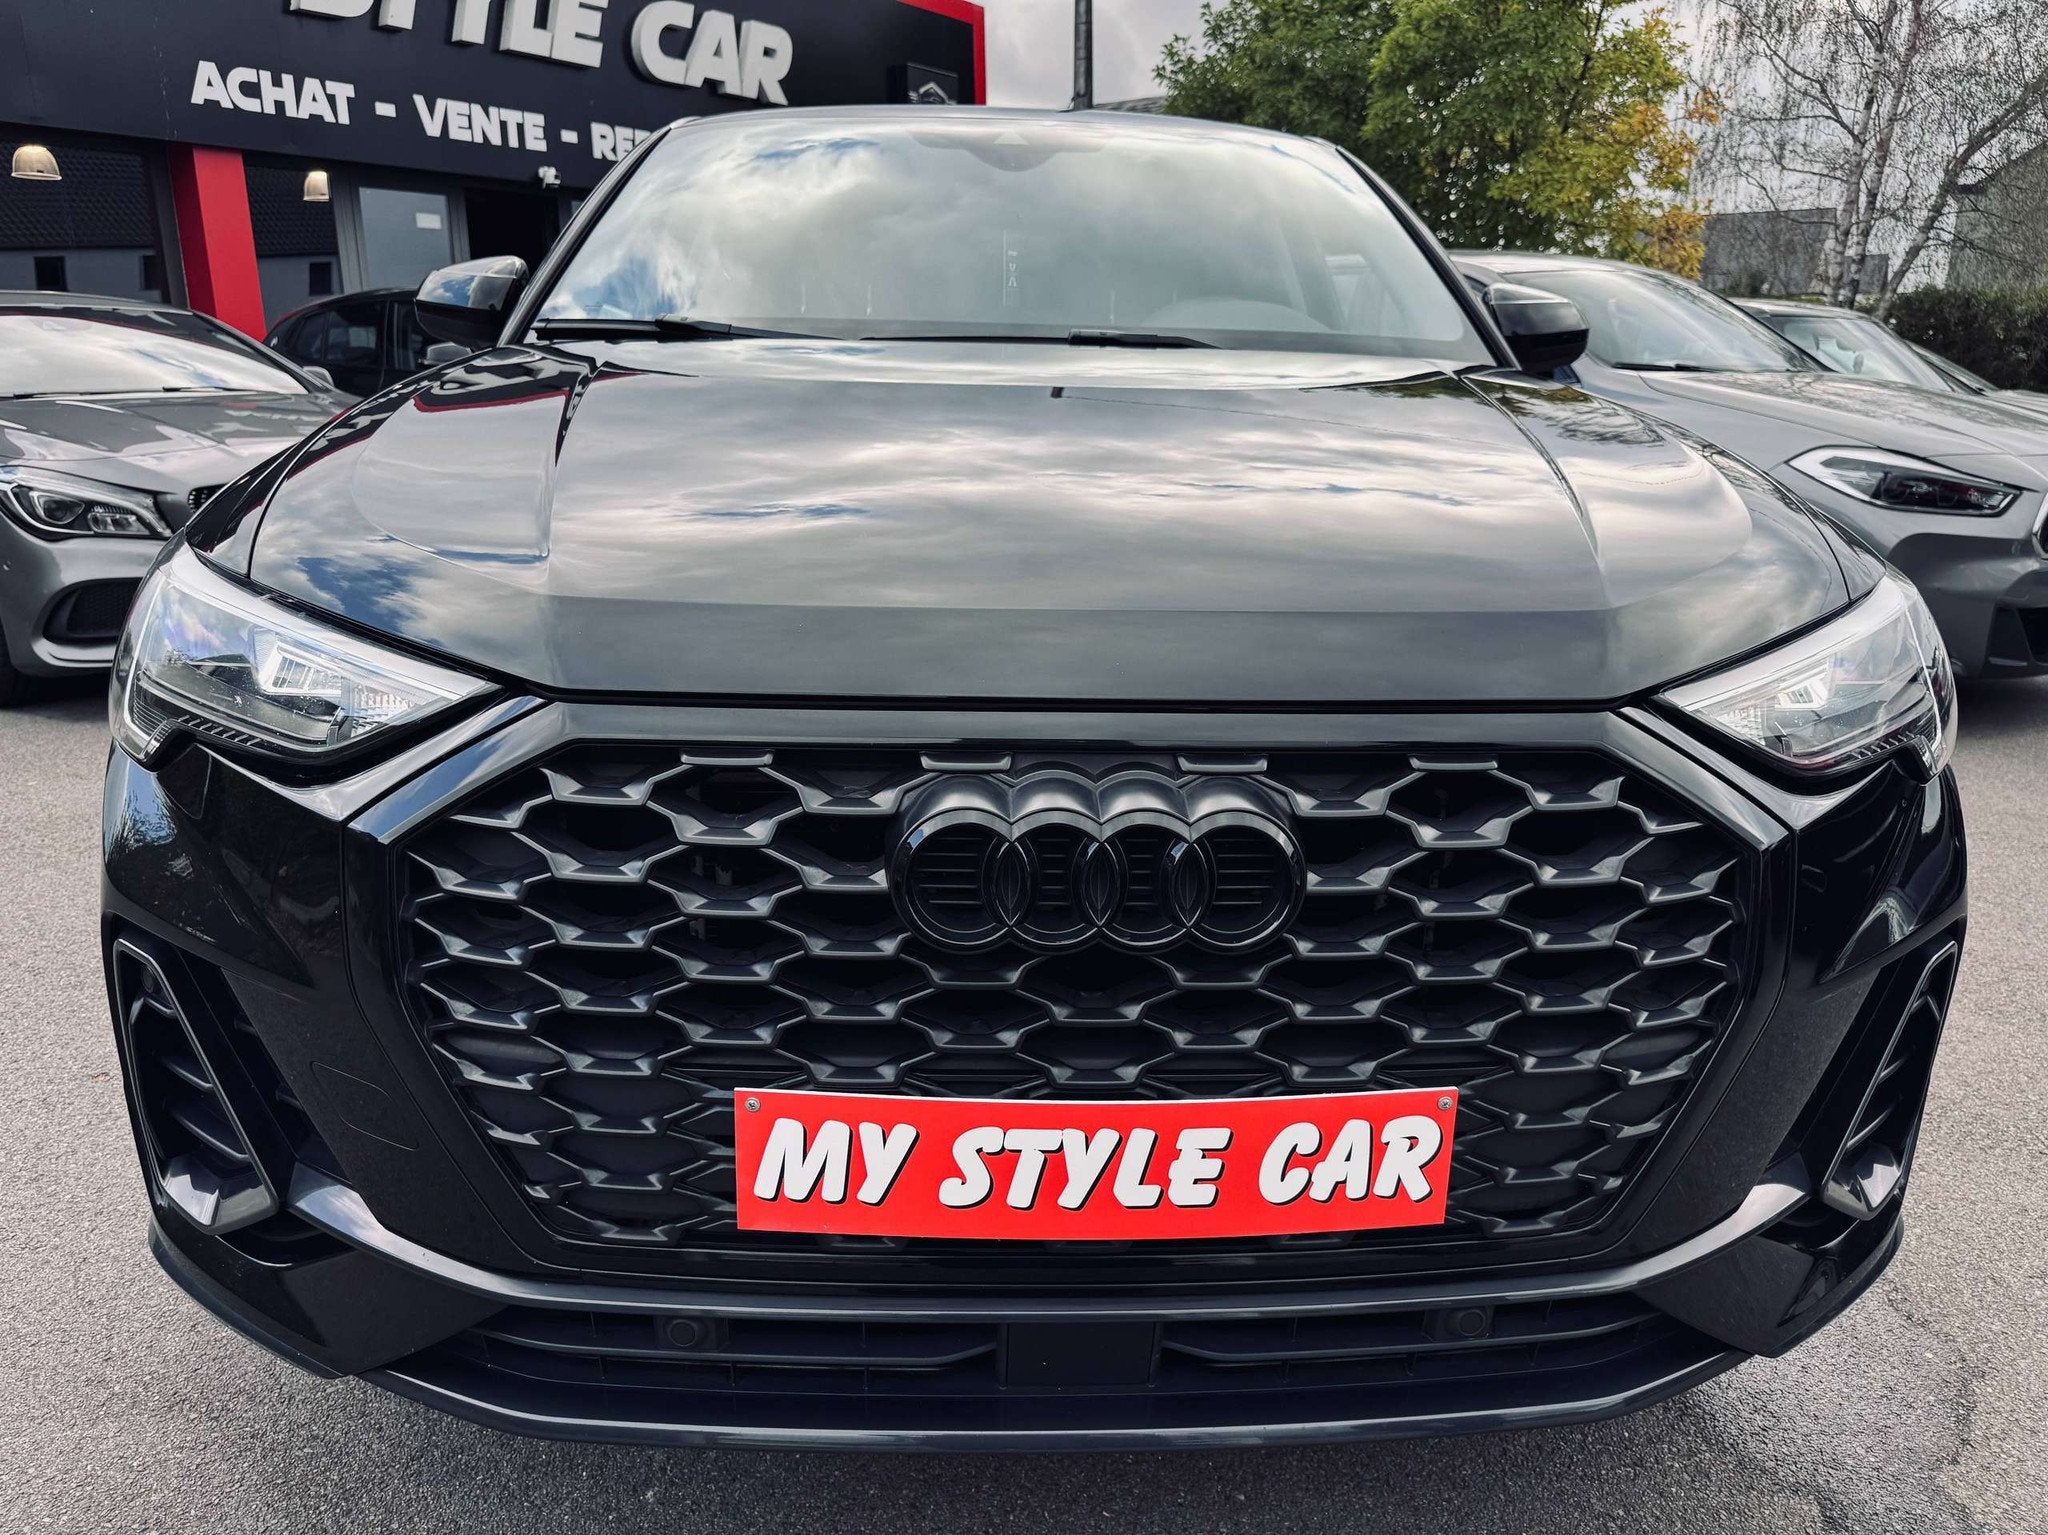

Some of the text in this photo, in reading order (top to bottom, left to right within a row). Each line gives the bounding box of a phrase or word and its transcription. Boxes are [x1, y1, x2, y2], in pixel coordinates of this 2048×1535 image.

[631, 0, 793, 106] CAR
[190, 60, 355, 125] ACHAT
[413, 93, 547, 152] VENTE
[753, 1114, 1443, 1211] MY STYLE CAR
